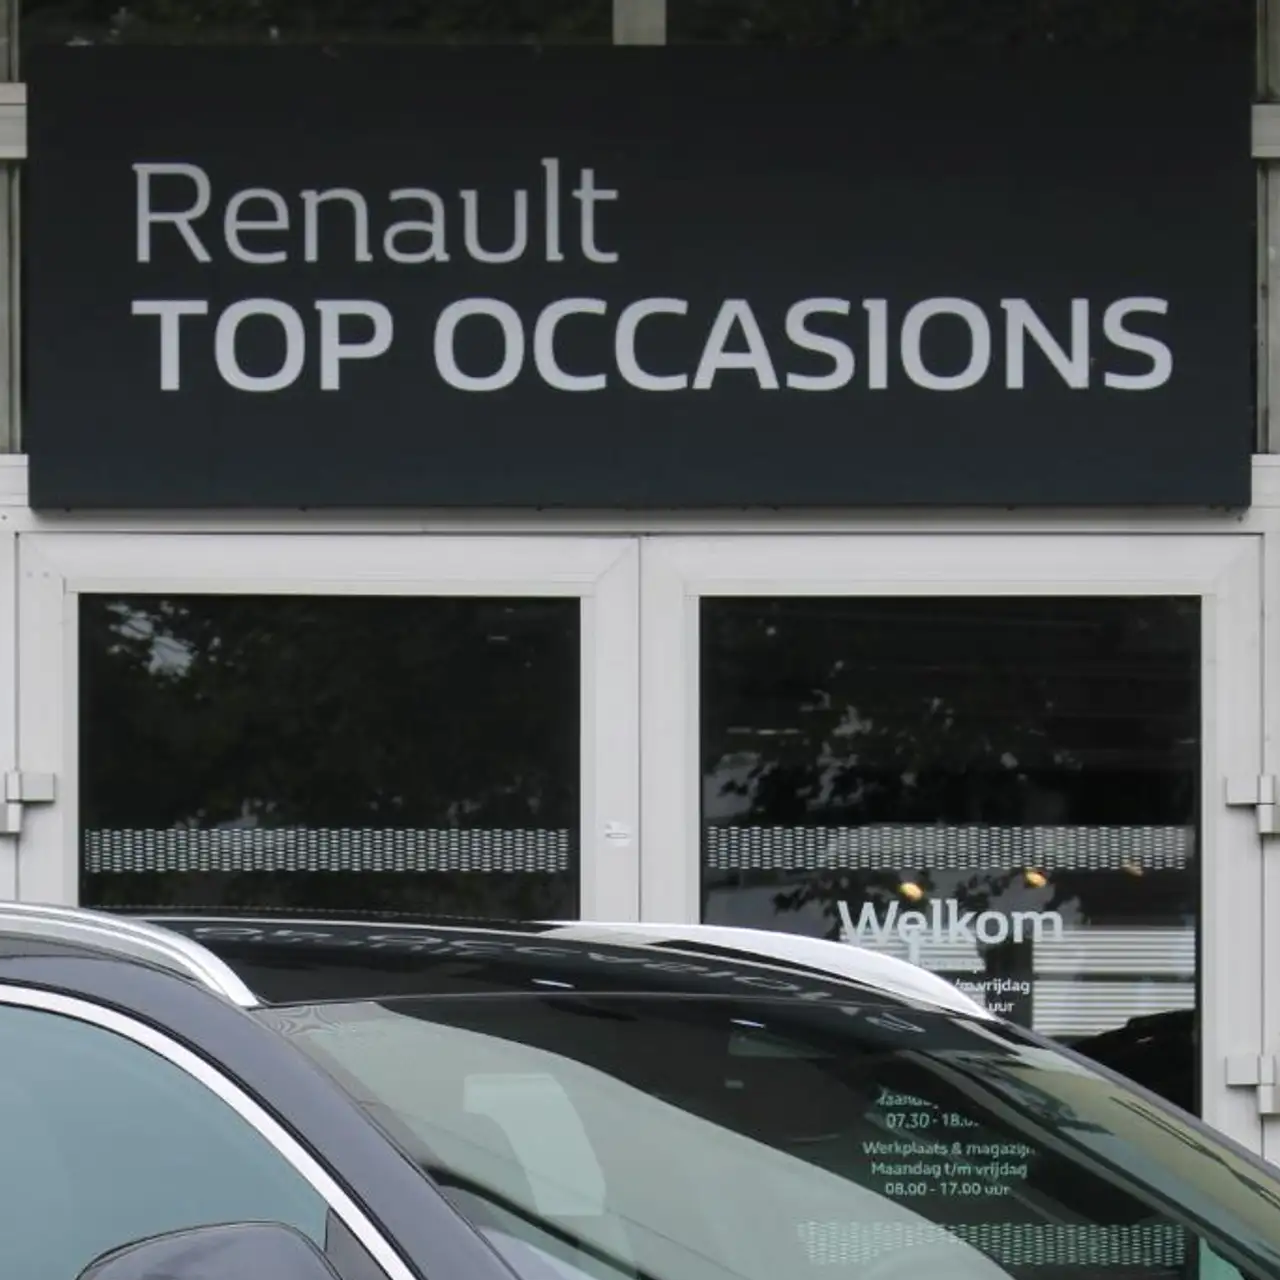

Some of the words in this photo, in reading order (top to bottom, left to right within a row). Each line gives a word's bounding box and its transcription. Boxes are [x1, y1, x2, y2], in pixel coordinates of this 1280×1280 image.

[133, 159, 617, 263] Renault
[132, 299, 393, 391] TOP
[434, 297, 1172, 391] OCCASIONS
[837, 899, 1063, 944] Welkom
[975, 977, 1030, 995] vrijdag
[886, 1112, 930, 1128] 07.30
[862, 1140, 949, 1157] Werkplaats
[951, 1141, 962, 1155] &
[871, 1162, 941, 1179] Maandag
[944, 1162, 972, 1177] t/m
[975, 1162, 1027, 1180] vrijdag
[885, 1182, 928, 1196] 08.00
[940, 1182, 982, 1196] 17.00
[984, 1185, 1010, 1196] uur
